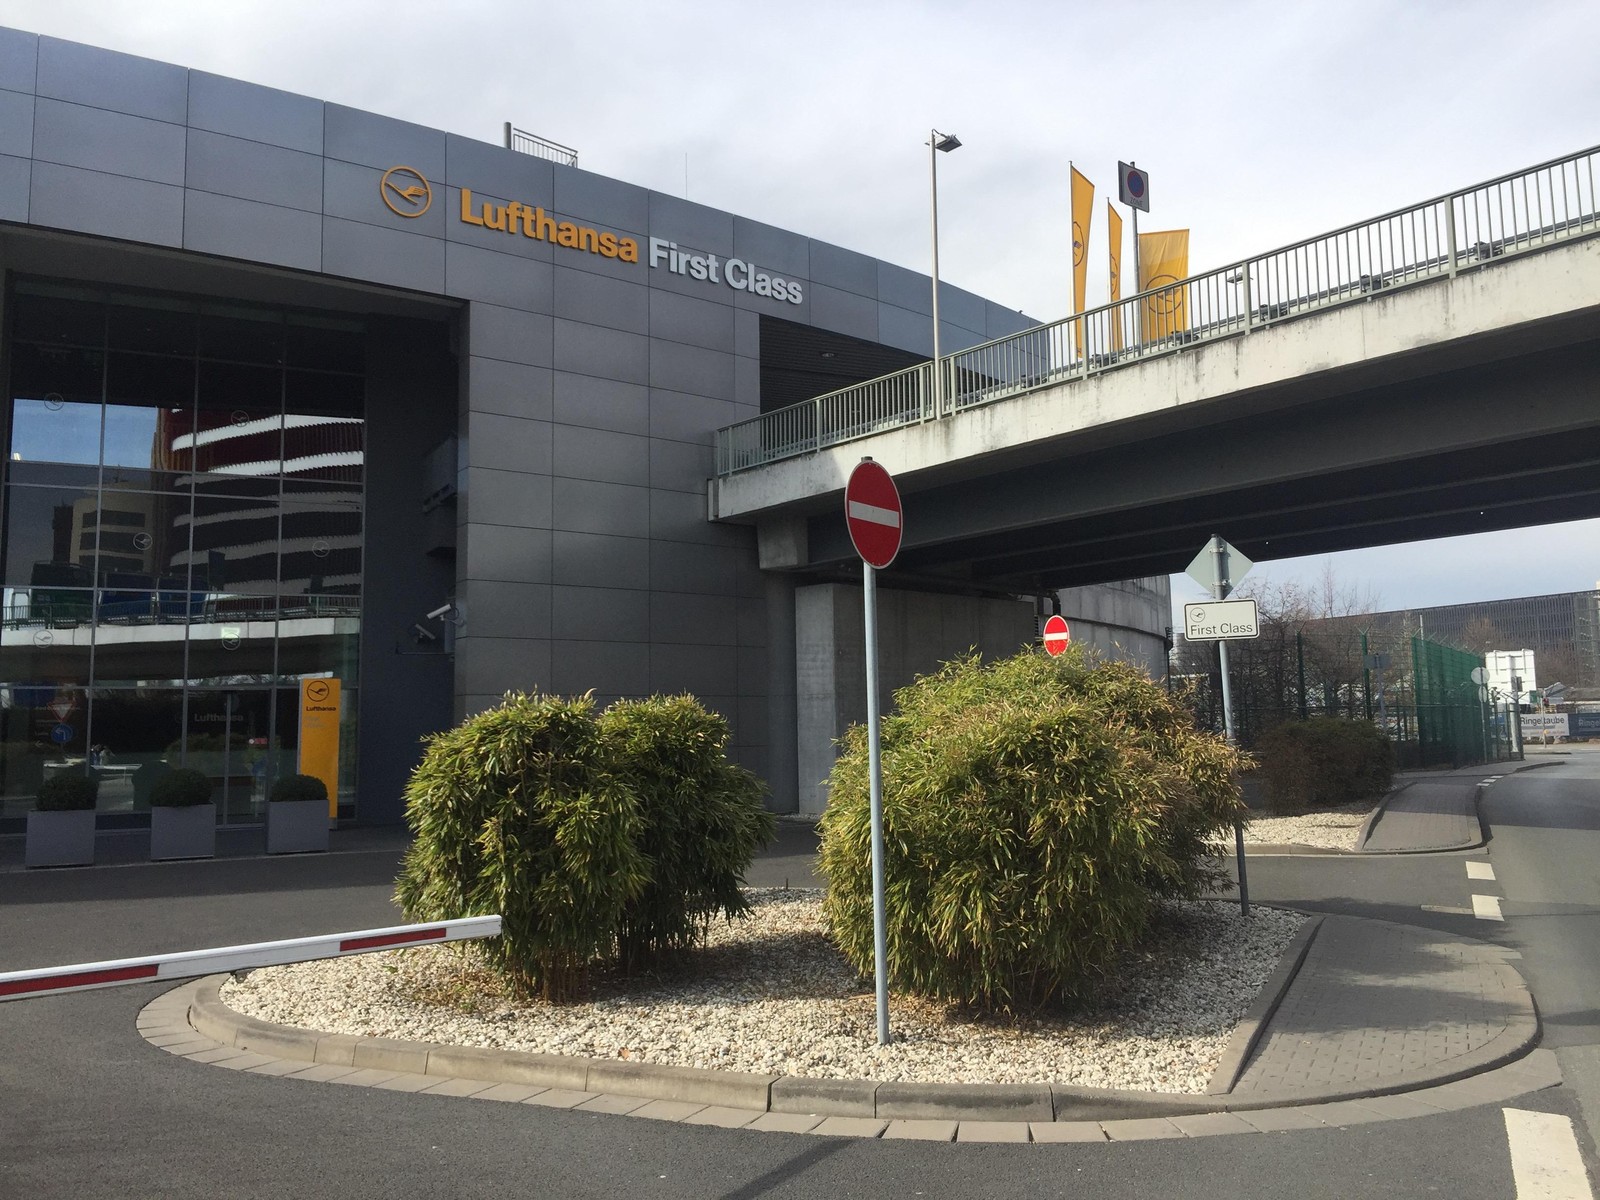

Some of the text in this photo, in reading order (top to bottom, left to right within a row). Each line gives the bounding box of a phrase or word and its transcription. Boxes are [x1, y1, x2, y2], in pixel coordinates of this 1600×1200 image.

[460, 188, 803, 305] Lufthansa First Class
[1190, 623, 1253, 635] First Class
